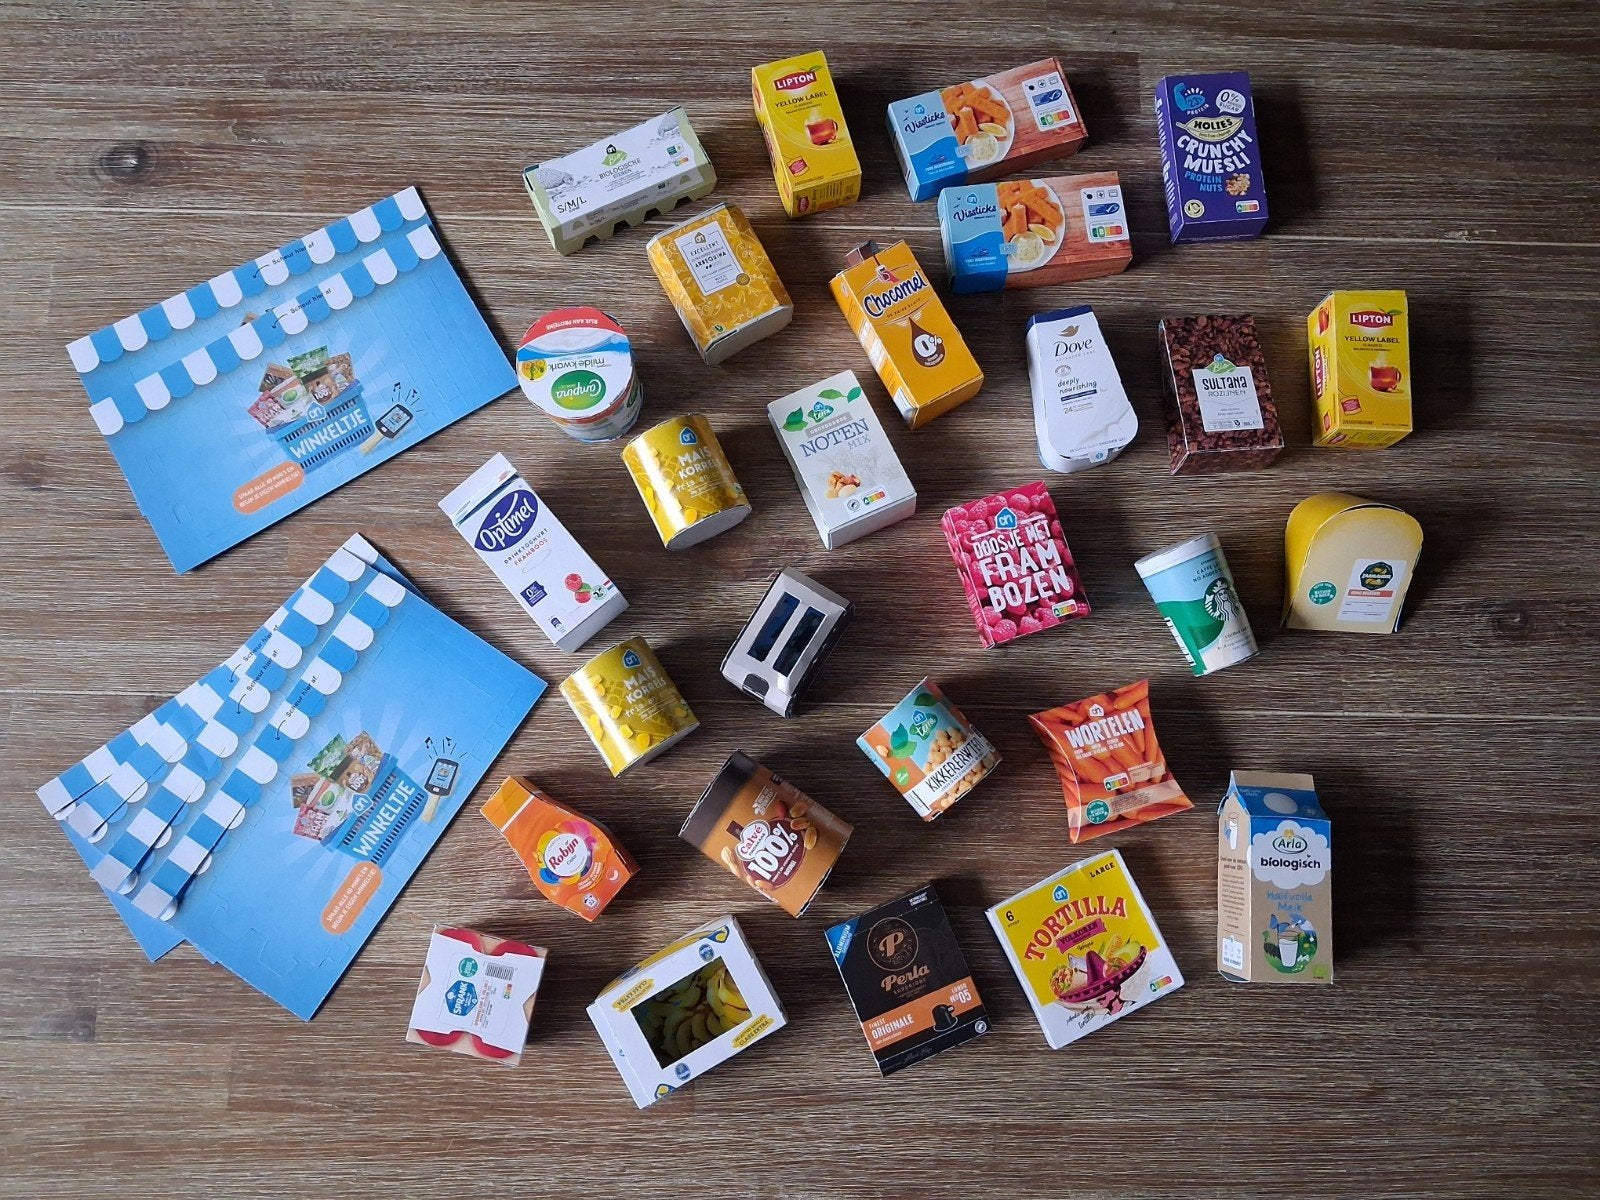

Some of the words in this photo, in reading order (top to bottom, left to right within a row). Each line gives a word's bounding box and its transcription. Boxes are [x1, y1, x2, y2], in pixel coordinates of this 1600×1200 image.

[776, 73, 814, 89] LIPTON
[774, 96, 804, 108] YELLOW
[805, 91, 829, 102] LABEL
[1218, 102, 1239, 112] SUGAR
[1187, 103, 1209, 116] PROTEIN
[904, 111, 946, 133] Vissticks
[1194, 117, 1233, 130] HOLIE'S
[1177, 129, 1253, 159] CRUNCHY
[599, 157, 642, 179] BIOLOGISCHE
[1183, 151, 1251, 174] MUESLI
[1185, 171, 1222, 183] PROTEIN
[1200, 183, 1223, 192] NUTS
[557, 196, 587, 214] S/M/L
[953, 204, 997, 222] Vissticks
[272, 250, 294, 265] Scheur
[295, 245, 306, 254] hier
[690, 241, 720, 256] EXCELLENT
[694, 252, 726, 268] ARBEQUINA
[290, 299, 311, 314] Scheur
[312, 293, 324, 302] hier
[864, 271, 927, 318] Chocomel
[1352, 314, 1391, 324] LIPTON
[914, 334, 943, 358] 0%
[1053, 338, 1093, 357] Dove
[1377, 336, 1400, 344] LABEL
[548, 362, 577, 371] kwark
[578, 358, 605, 367] milde
[1314, 347, 1322, 396] LIPTON
[556, 379, 602, 398] Campina
[1057, 377, 1080, 388] deeply
[1059, 381, 1097, 394] nourishing
[1208, 390, 1246, 398] ROZIJNEN
[290, 408, 367, 459] WINKELTJE
[799, 418, 870, 457] NOTEN
[848, 435, 871, 450] MIX
[678, 446, 712, 466] MAIS
[479, 492, 535, 550] Optimel
[504, 528, 549, 565] DRINKYOGHURT
[973, 529, 1024, 558] DOOSJE
[1025, 519, 1051, 543] MET
[514, 538, 548, 566] FRAMBOOS
[978, 539, 1061, 586] FRAM
[988, 566, 1070, 613] BOZEN
[243, 641, 262, 662] Scheur
[262, 631, 273, 645] hier
[247, 671, 264, 692] Scheur
[263, 658, 273, 672] hier
[272, 650, 278, 658] af
[624, 666, 656, 690] MAIS
[286, 695, 303, 717] Scheur
[302, 683, 312, 696] hier
[311, 676, 318, 684] af
[625, 677, 666, 704] KORRELS
[1064, 709, 1145, 748] WORTELEN
[352, 780, 415, 857] WINKELTJE
[740, 825, 763, 855] Calvé
[1277, 838, 1302, 849] Arla
[549, 838, 579, 870] Robijn
[567, 855, 577, 865] Color
[748, 822, 798, 880] 100%
[1089, 862, 1116, 878] LARGE
[1260, 856, 1321, 871] biologisch
[337, 893, 348, 906] ALLE
[1267, 890, 1313, 901] Halfvolle
[1277, 901, 1303, 912] Melk
[331, 913, 344, 929] BEGIN
[1005, 911, 1015, 922] 6
[1024, 895, 1127, 962] TORTILLA
[1060, 921, 1099, 945] VOLKOREN
[632, 980, 648, 993] CLASS
[880, 964, 930, 992] Perla
[617, 990, 634, 1006] EXTRA
[739, 1032, 754, 1046] CLASS
[754, 1020, 770, 1034] EXTRA
[869, 1018, 887, 1029] FINEST
[871, 1014, 914, 1038] ORIGINALE
